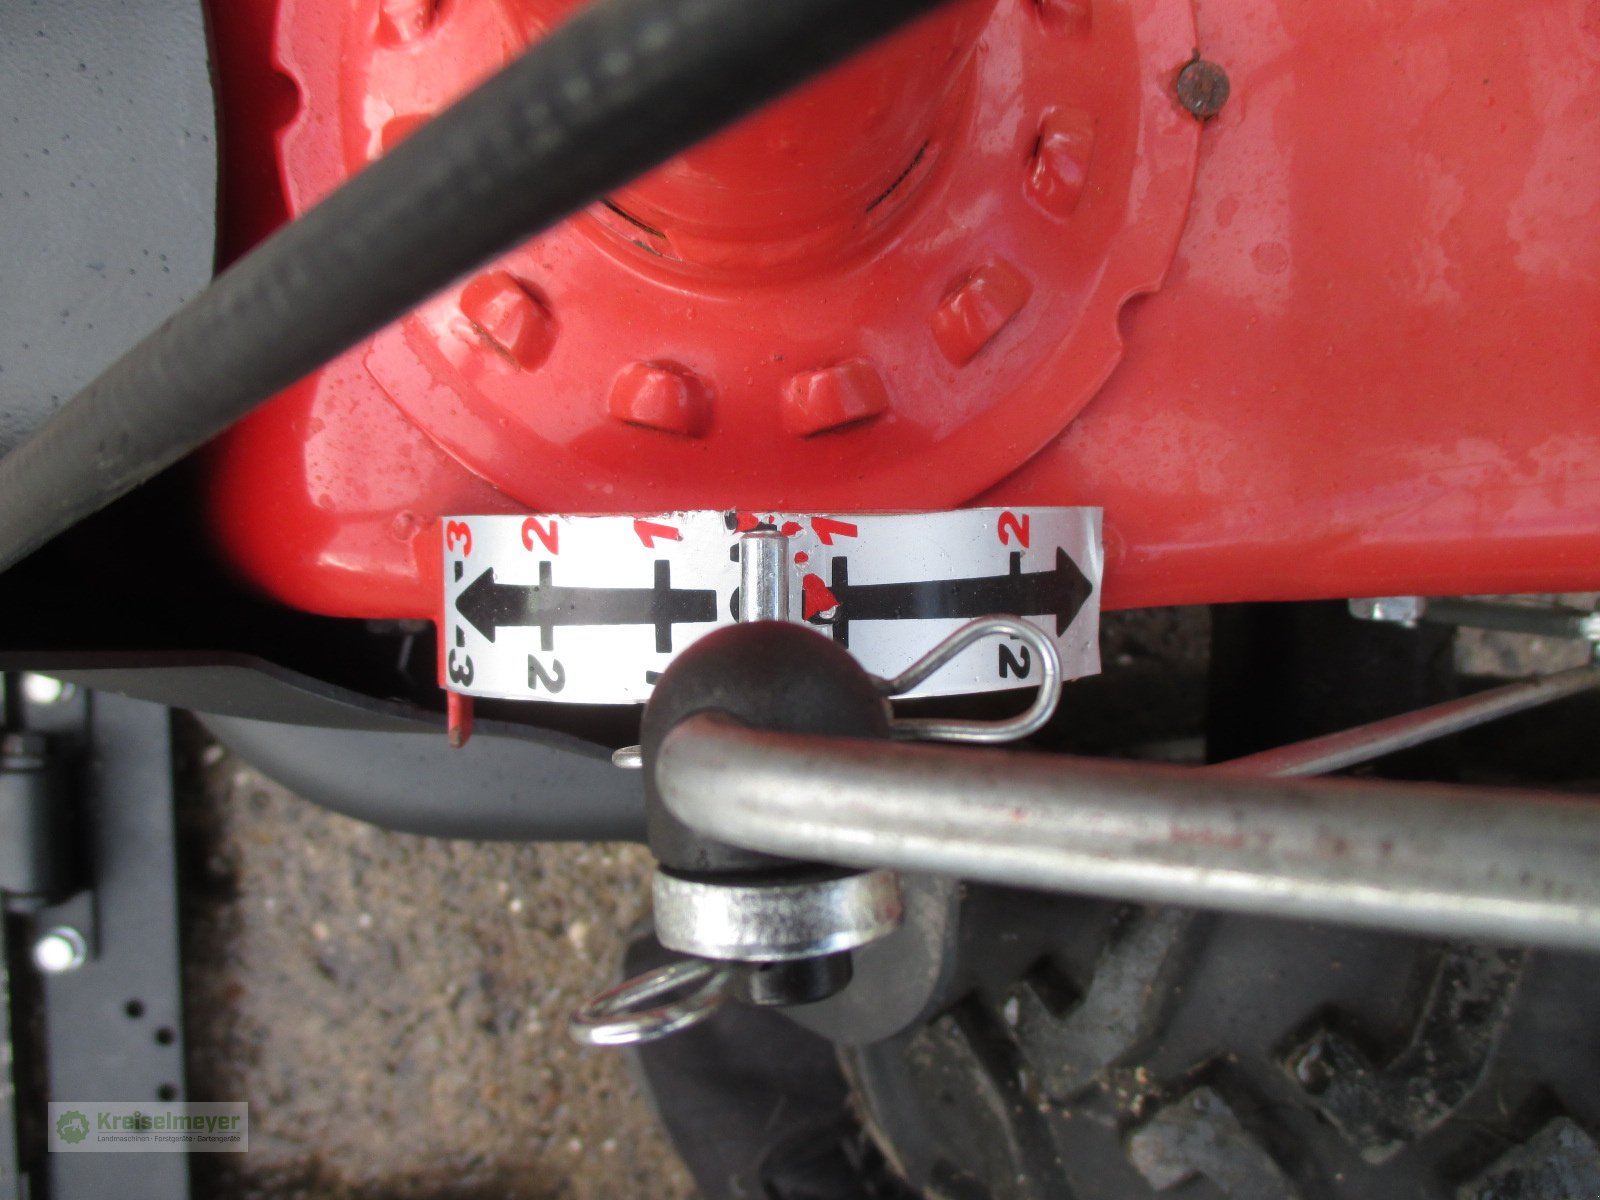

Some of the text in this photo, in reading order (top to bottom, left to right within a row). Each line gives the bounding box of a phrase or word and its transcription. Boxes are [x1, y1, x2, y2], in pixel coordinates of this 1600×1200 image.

[447, 520, 473, 557] 3
[521, 517, 559, 555] 2
[633, 520, 684, 548] 1
[811, 517, 858, 546] 1
[998, 511, 1030, 548] 2
[448, 648, 474, 687] 3
[528, 654, 566, 693] 2
[999, 643, 1031, 679] 2
